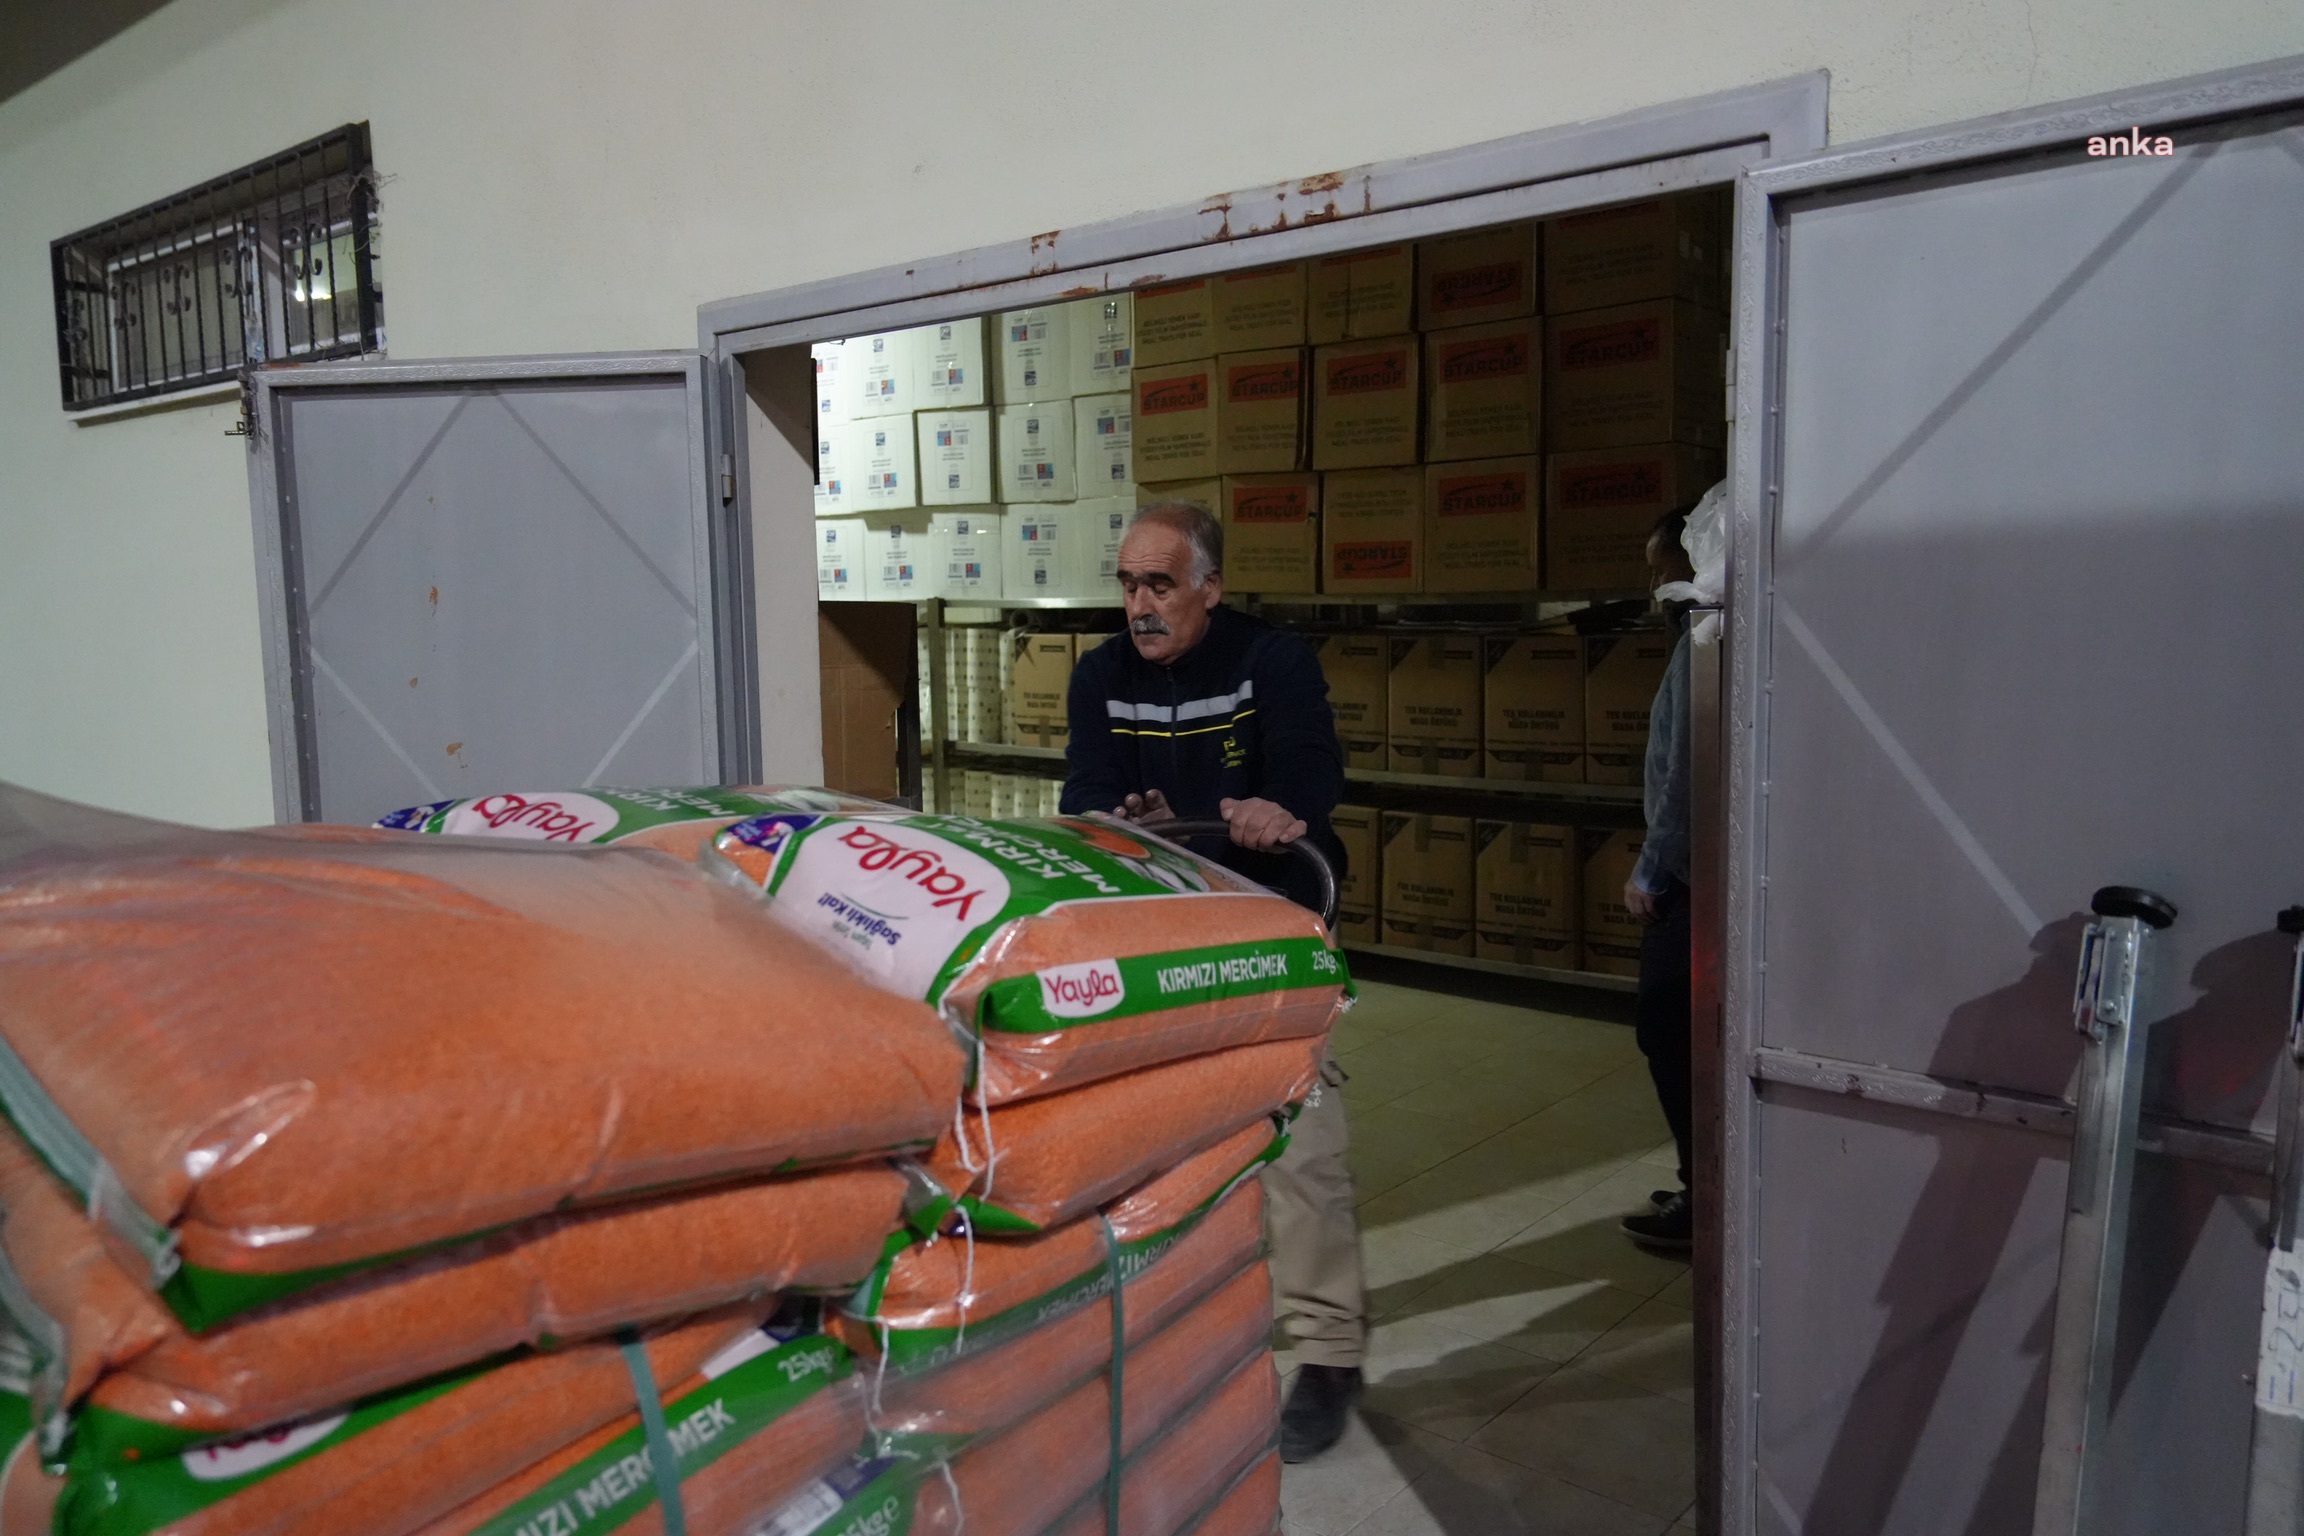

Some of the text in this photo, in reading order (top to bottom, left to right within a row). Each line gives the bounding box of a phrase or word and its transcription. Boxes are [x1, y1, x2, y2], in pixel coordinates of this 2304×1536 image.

[1143, 392, 1205, 412] STARCUP
[1237, 505, 1303, 518] STARCUP
[472, 794, 596, 842] Yayla
[837, 825, 986, 922] Yayla
[846, 908, 902, 946] Sağlıklı
[1045, 969, 1120, 1008] Yayla
[1157, 963, 1218, 994] KIRMIZI
[1219, 948, 1288, 985] MERCİMEK
